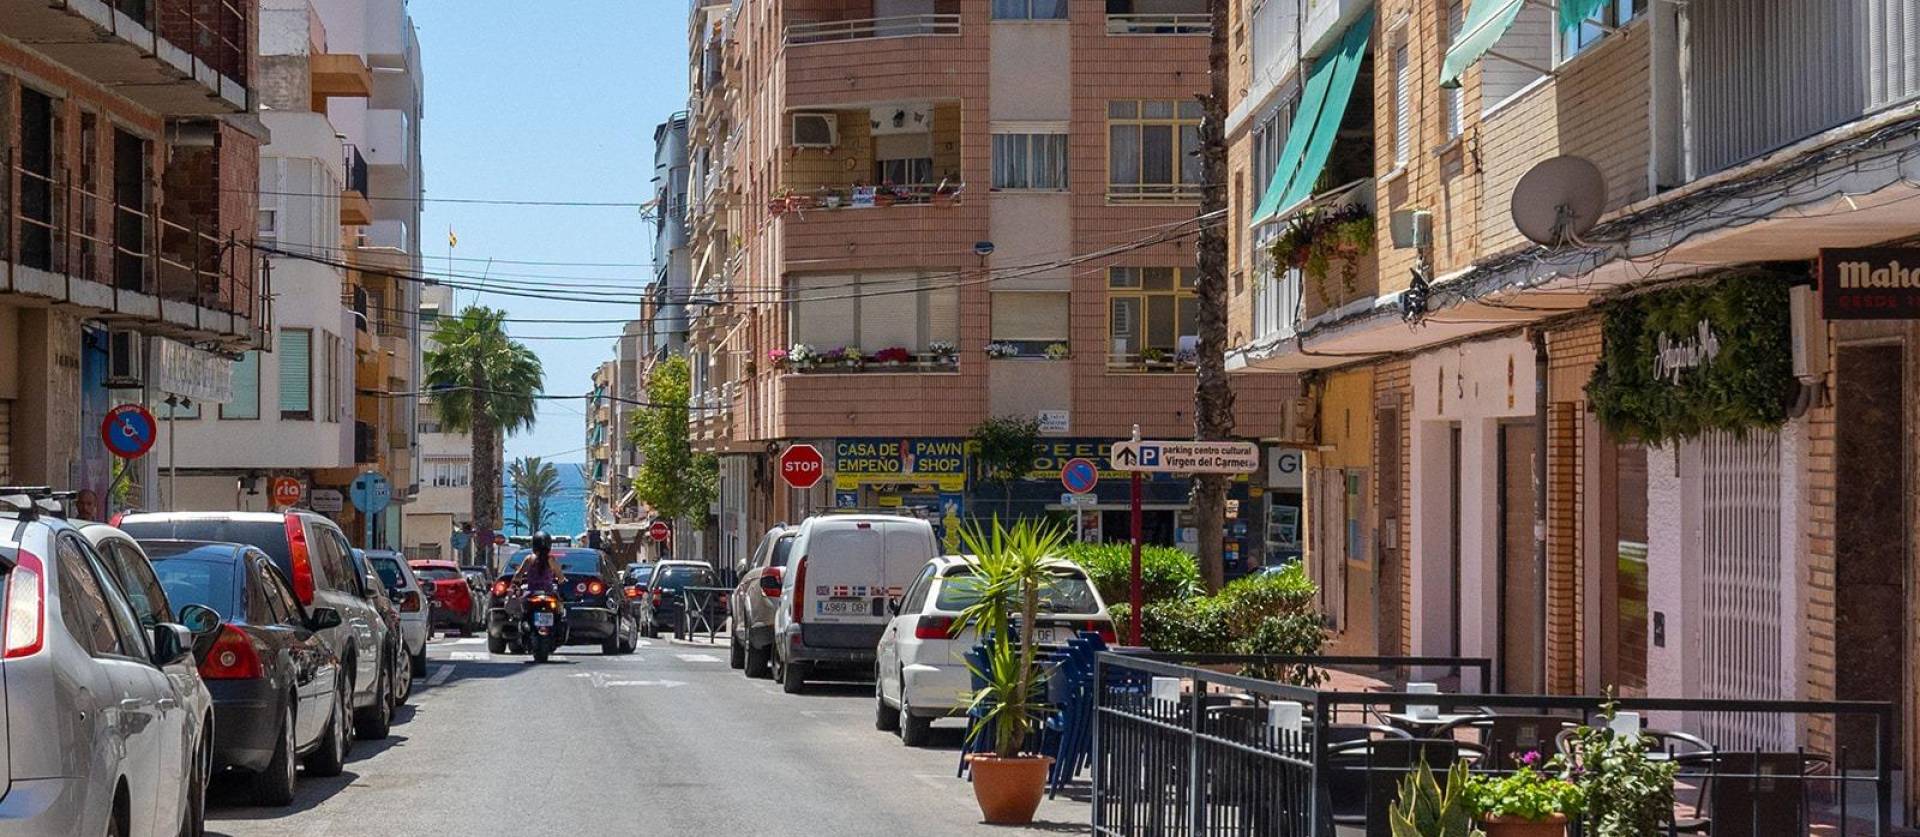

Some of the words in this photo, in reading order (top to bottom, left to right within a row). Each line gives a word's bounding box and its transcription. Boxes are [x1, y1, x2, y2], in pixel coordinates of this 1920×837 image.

[838, 443, 876, 456] CASA
[880, 443, 899, 456] DE
[916, 443, 962, 455] PAWN
[1163, 446, 1192, 456] parking
[1194, 447, 1219, 455] centro
[1221, 446, 1252, 455] cultural
[785, 461, 819, 472] STOP
[838, 456, 899, 472] EMPEÑO
[919, 459, 960, 471] SHOP
[1166, 456, 1196, 468] Virgen
[1198, 457, 1213, 466] del
[1278, 453, 1303, 474] G
[277, 481, 299, 496] ria
